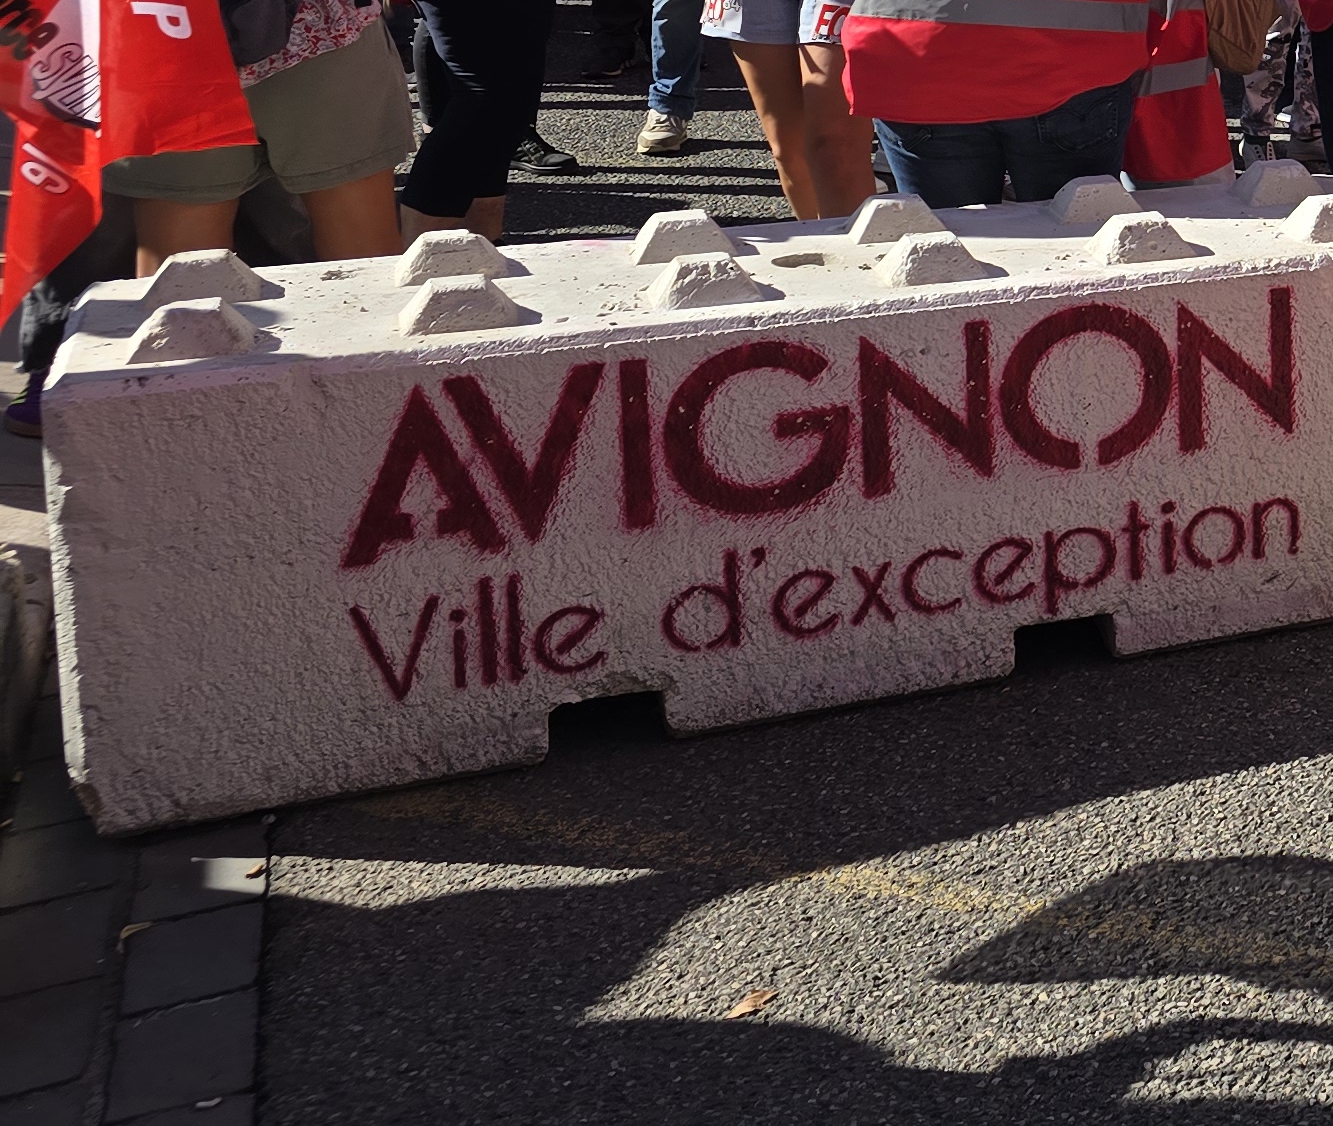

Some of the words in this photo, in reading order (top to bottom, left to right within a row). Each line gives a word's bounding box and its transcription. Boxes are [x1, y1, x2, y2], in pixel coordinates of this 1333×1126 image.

[340, 284, 1296, 568] AVIGNON
[350, 571, 608, 702] Ville
[661, 496, 1300, 655] d'exception
